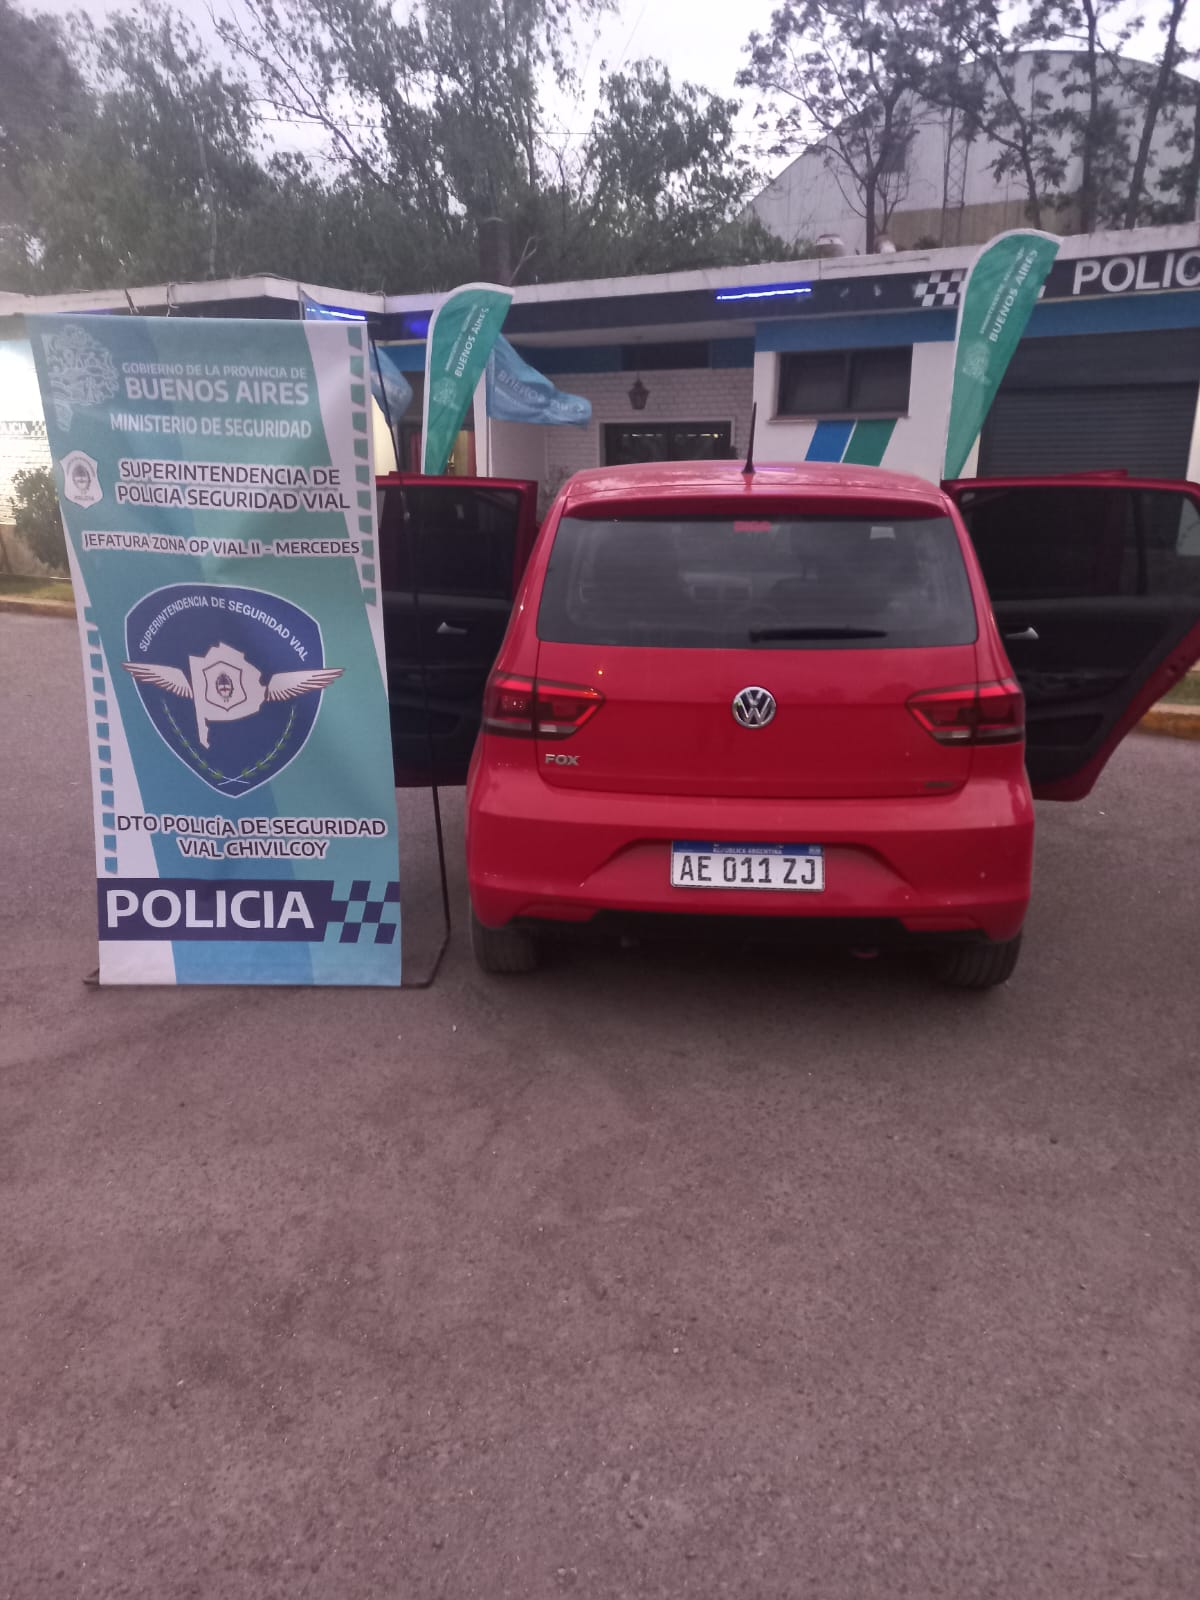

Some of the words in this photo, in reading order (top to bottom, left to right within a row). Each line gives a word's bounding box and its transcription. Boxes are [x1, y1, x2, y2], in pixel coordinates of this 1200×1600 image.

[988, 287, 1018, 343] BUENOS
[1015, 249, 1038, 286] AIRES
[454, 335, 476, 378] BUENOS
[471, 307, 490, 335] AIRES
[122, 362, 183, 376] GOBIERNO
[186, 364, 201, 376] DE
[205, 365, 220, 377] LA
[223, 365, 288, 378] PROVINCIA
[290, 368, 307, 379] DE
[125, 376, 229, 402] BUENOS
[236, 381, 309, 406] AIRES
[109, 413, 197, 434] MINISTERIO
[201, 417, 222, 435] DE
[225, 418, 312, 439] SEGURIDAD
[120, 461, 307, 485] SUPERINTENDENCIA
[313, 469, 341, 486] DE
[117, 485, 183, 505] POLICIA
[187, 488, 298, 510] SEGURIDAD
[302, 491, 351, 509] VIAL
[83, 533, 149, 549] JEFATURA
[152, 536, 186, 551] ZONA
[189, 539, 209, 553] OP
[213, 540, 248, 555] VIAL
[276, 540, 360, 555] MERCEDES
[139, 596, 208, 652] SUPERINTENDENCIA
[211, 596, 226, 609] DE
[228, 600, 290, 640] SEGURIDAD
[289, 633, 310, 662] VIAL
[544, 753, 581, 766] FOX
[117, 815, 158, 832] DTO
[163, 816, 236, 835] POLICÍA
[241, 819, 271, 835] DE
[272, 819, 386, 836] SEGURIDAD
[178, 838, 222, 857] VIAL
[226, 840, 329, 858] CHIVILCOY
[679, 855, 712, 882] AE
[723, 857, 772, 884] 011
[783, 858, 816, 885] ZJ
[106, 889, 315, 929] POLICIA
